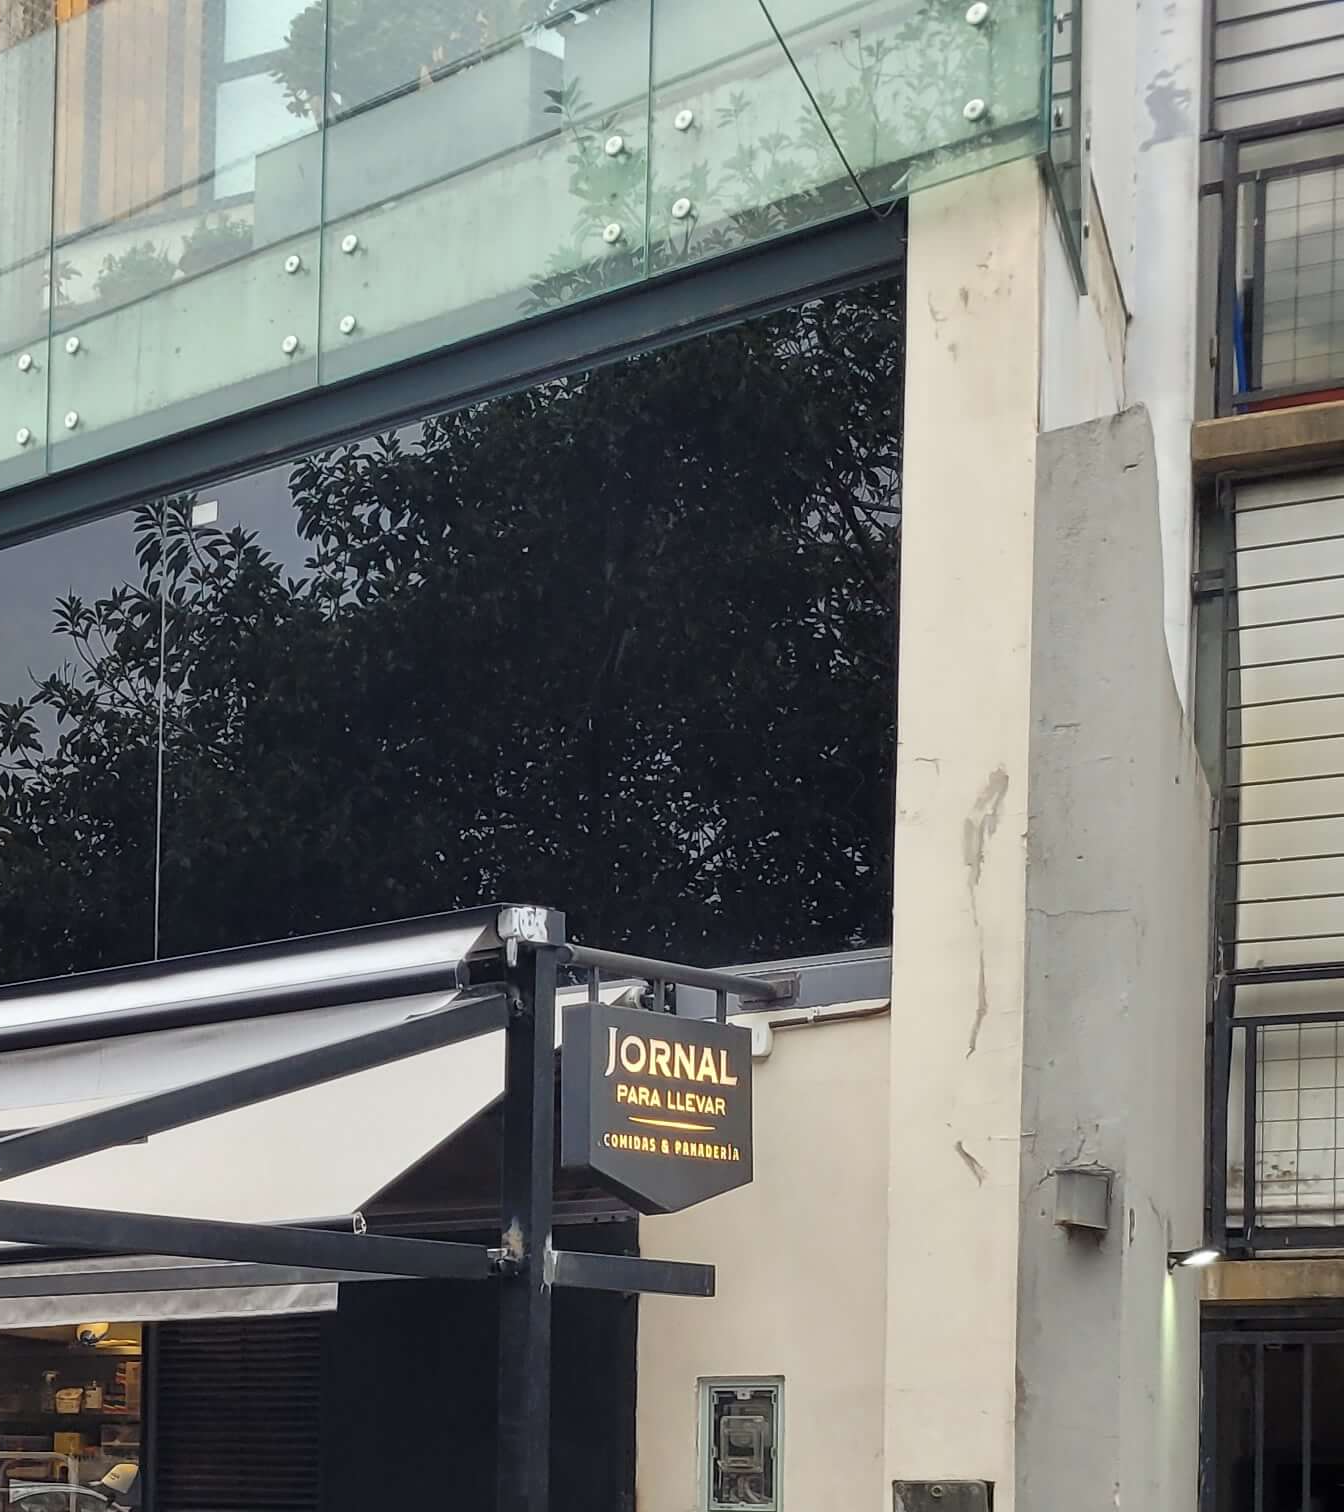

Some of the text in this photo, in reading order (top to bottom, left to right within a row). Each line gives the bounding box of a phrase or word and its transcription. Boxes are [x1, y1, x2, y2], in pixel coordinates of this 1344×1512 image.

[605, 1026, 738, 1086] JORNAL
[616, 1083, 727, 1116] PARA LLEVAR
[603, 1133, 740, 1161] COMIDAS & PANADERÍA
